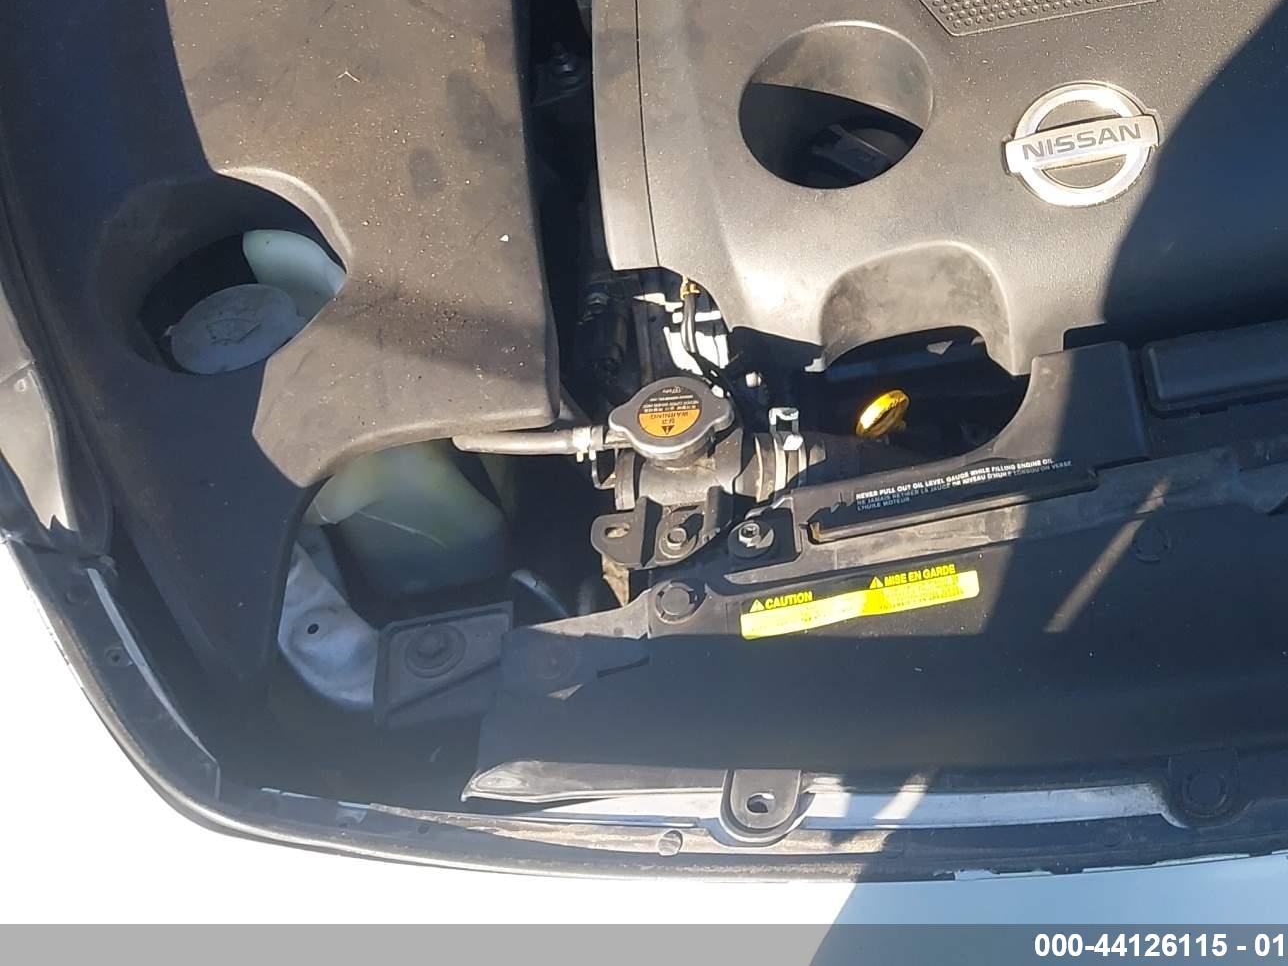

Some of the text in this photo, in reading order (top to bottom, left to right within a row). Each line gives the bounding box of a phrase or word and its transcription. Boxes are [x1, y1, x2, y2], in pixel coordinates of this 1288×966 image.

[1022, 123, 1142, 160] NISSAN
[651, 412, 689, 420] WARNING
[856, 457, 1054, 500] NEVER PULL OUT OIL LEVEL GAUGE WHILE FILLING ENGINE OIL
[883, 496, 910, 507] MOTEUR
[883, 564, 956, 587] MISE EN GARDE
[764, 591, 813, 610] CAUTION
